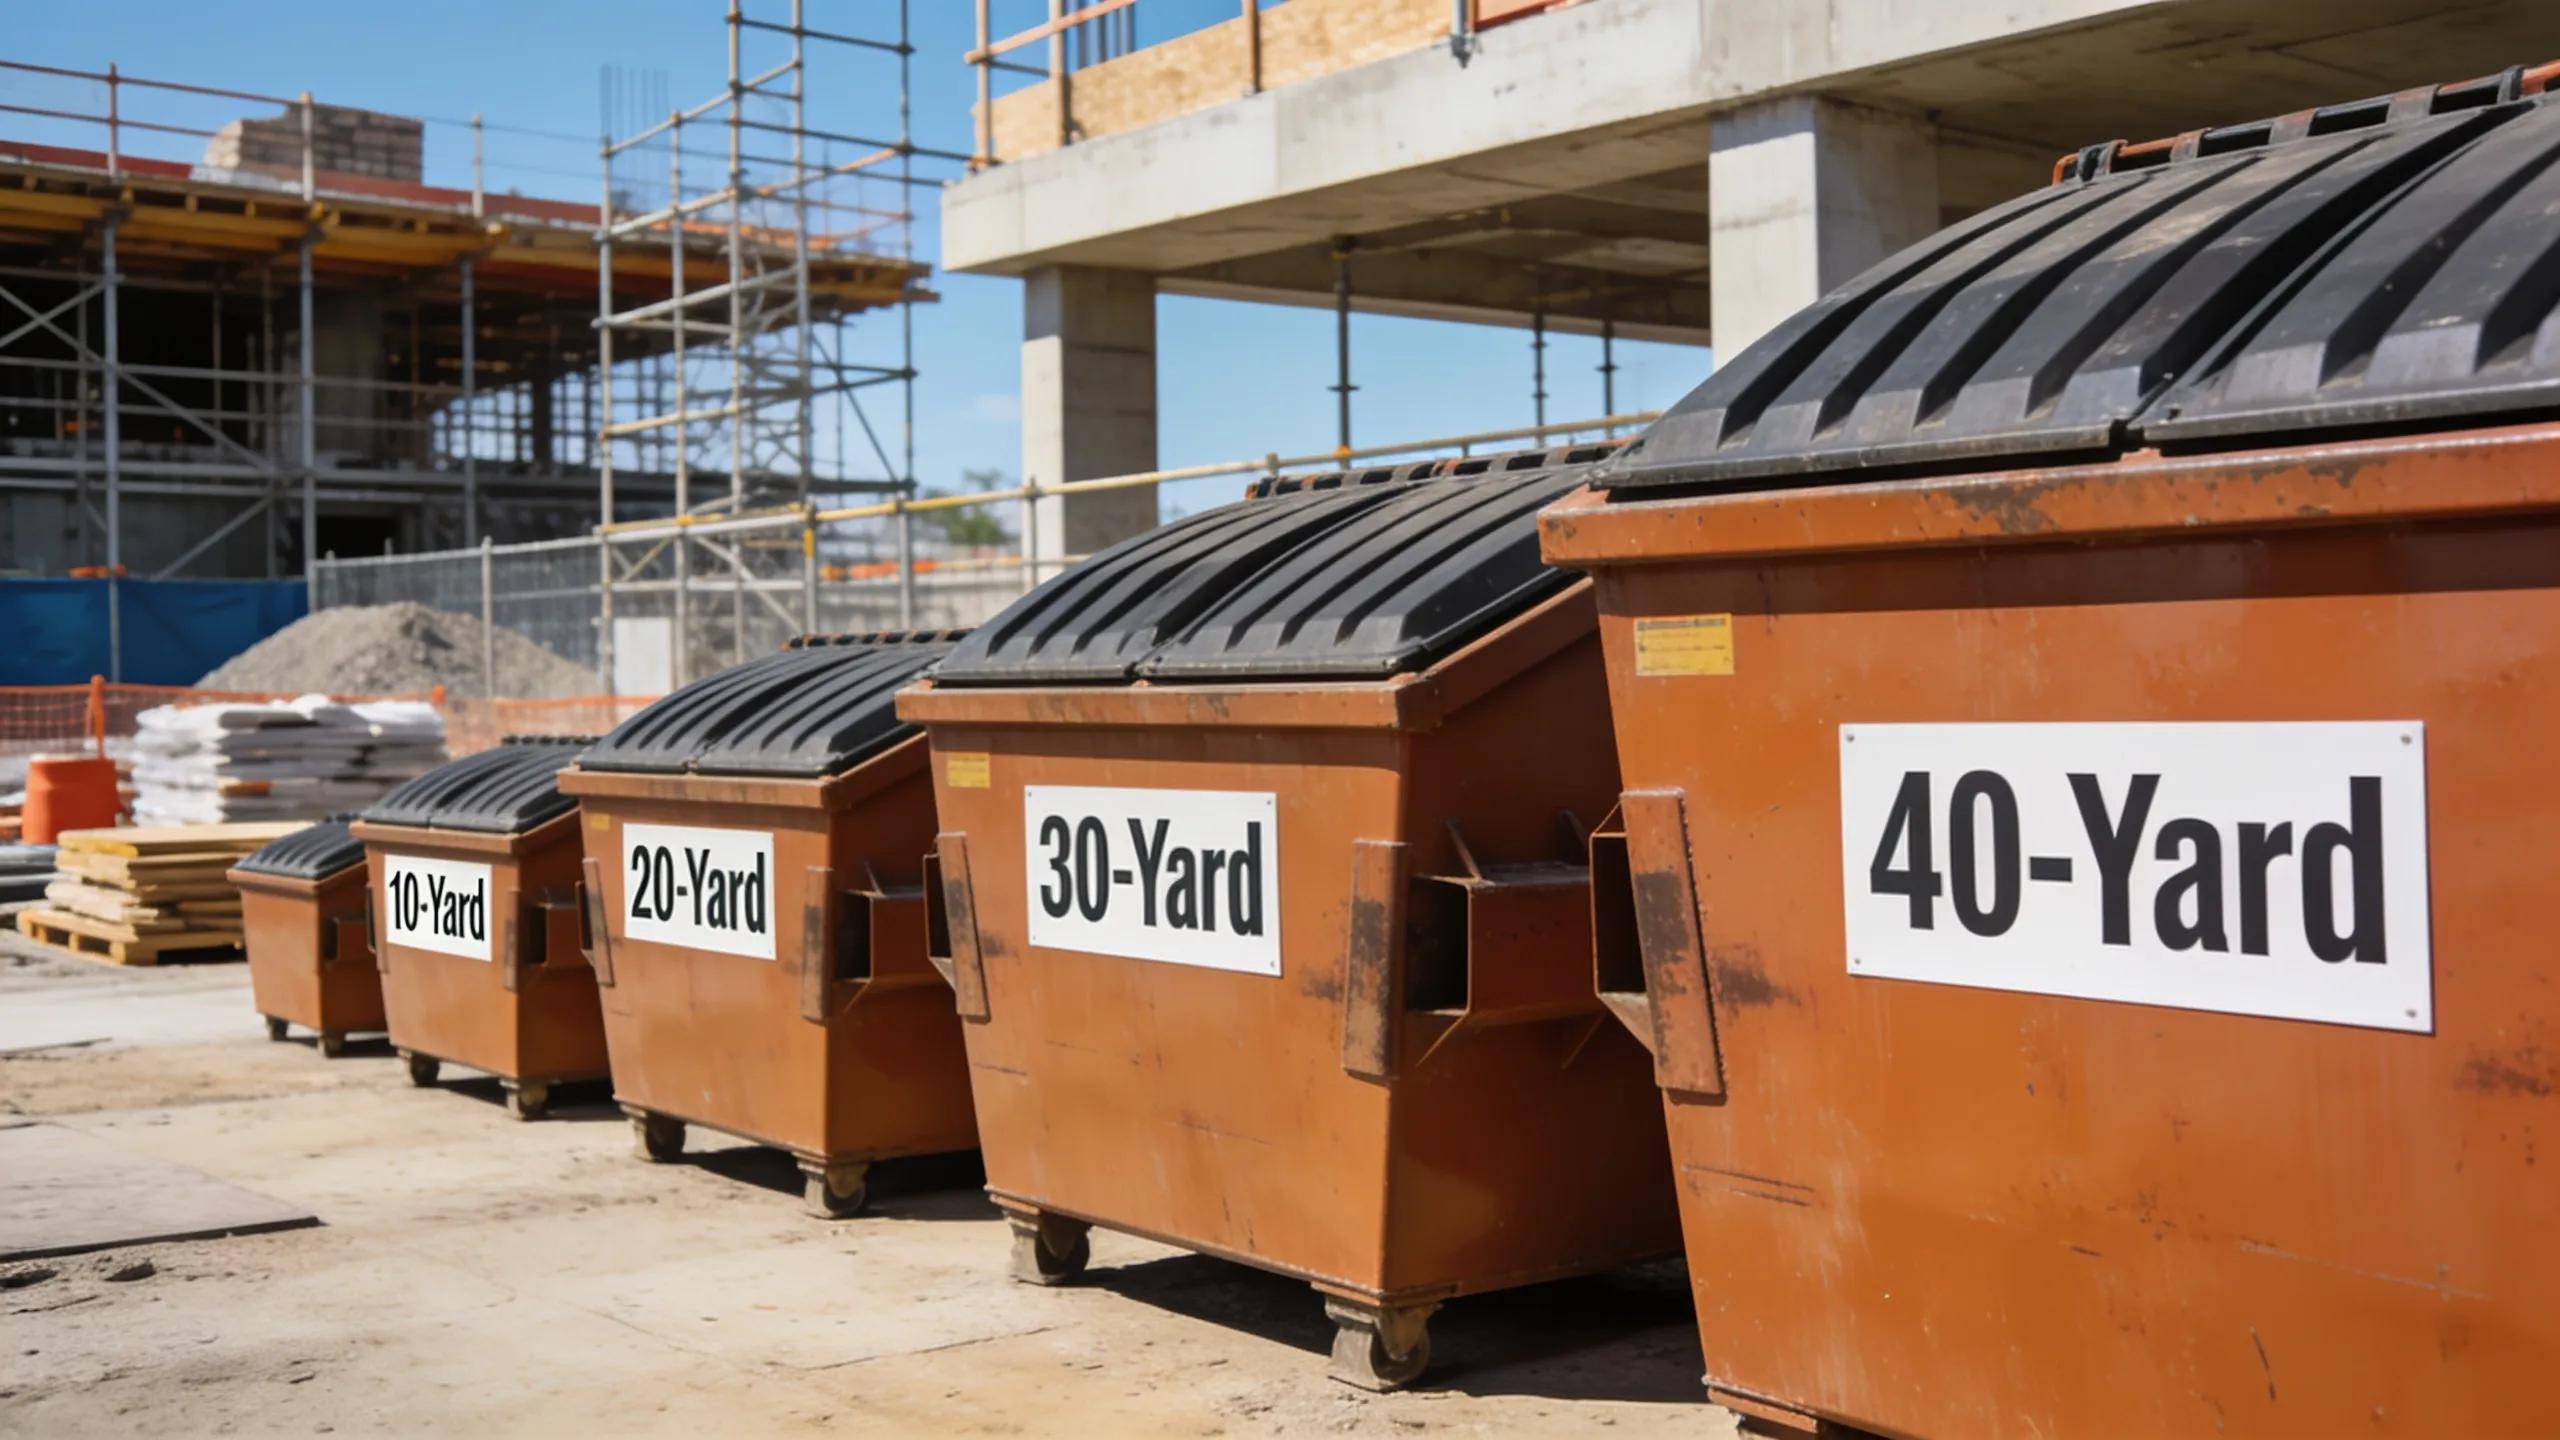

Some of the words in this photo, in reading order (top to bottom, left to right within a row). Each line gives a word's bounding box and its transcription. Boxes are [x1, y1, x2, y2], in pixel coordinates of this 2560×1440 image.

[388, 869, 485, 943] 10-Yard
[631, 844, 766, 935] 20-Yard
[1039, 814, 1264, 937] 30-Yard
[1870, 769, 2388, 965] 40-Yard
